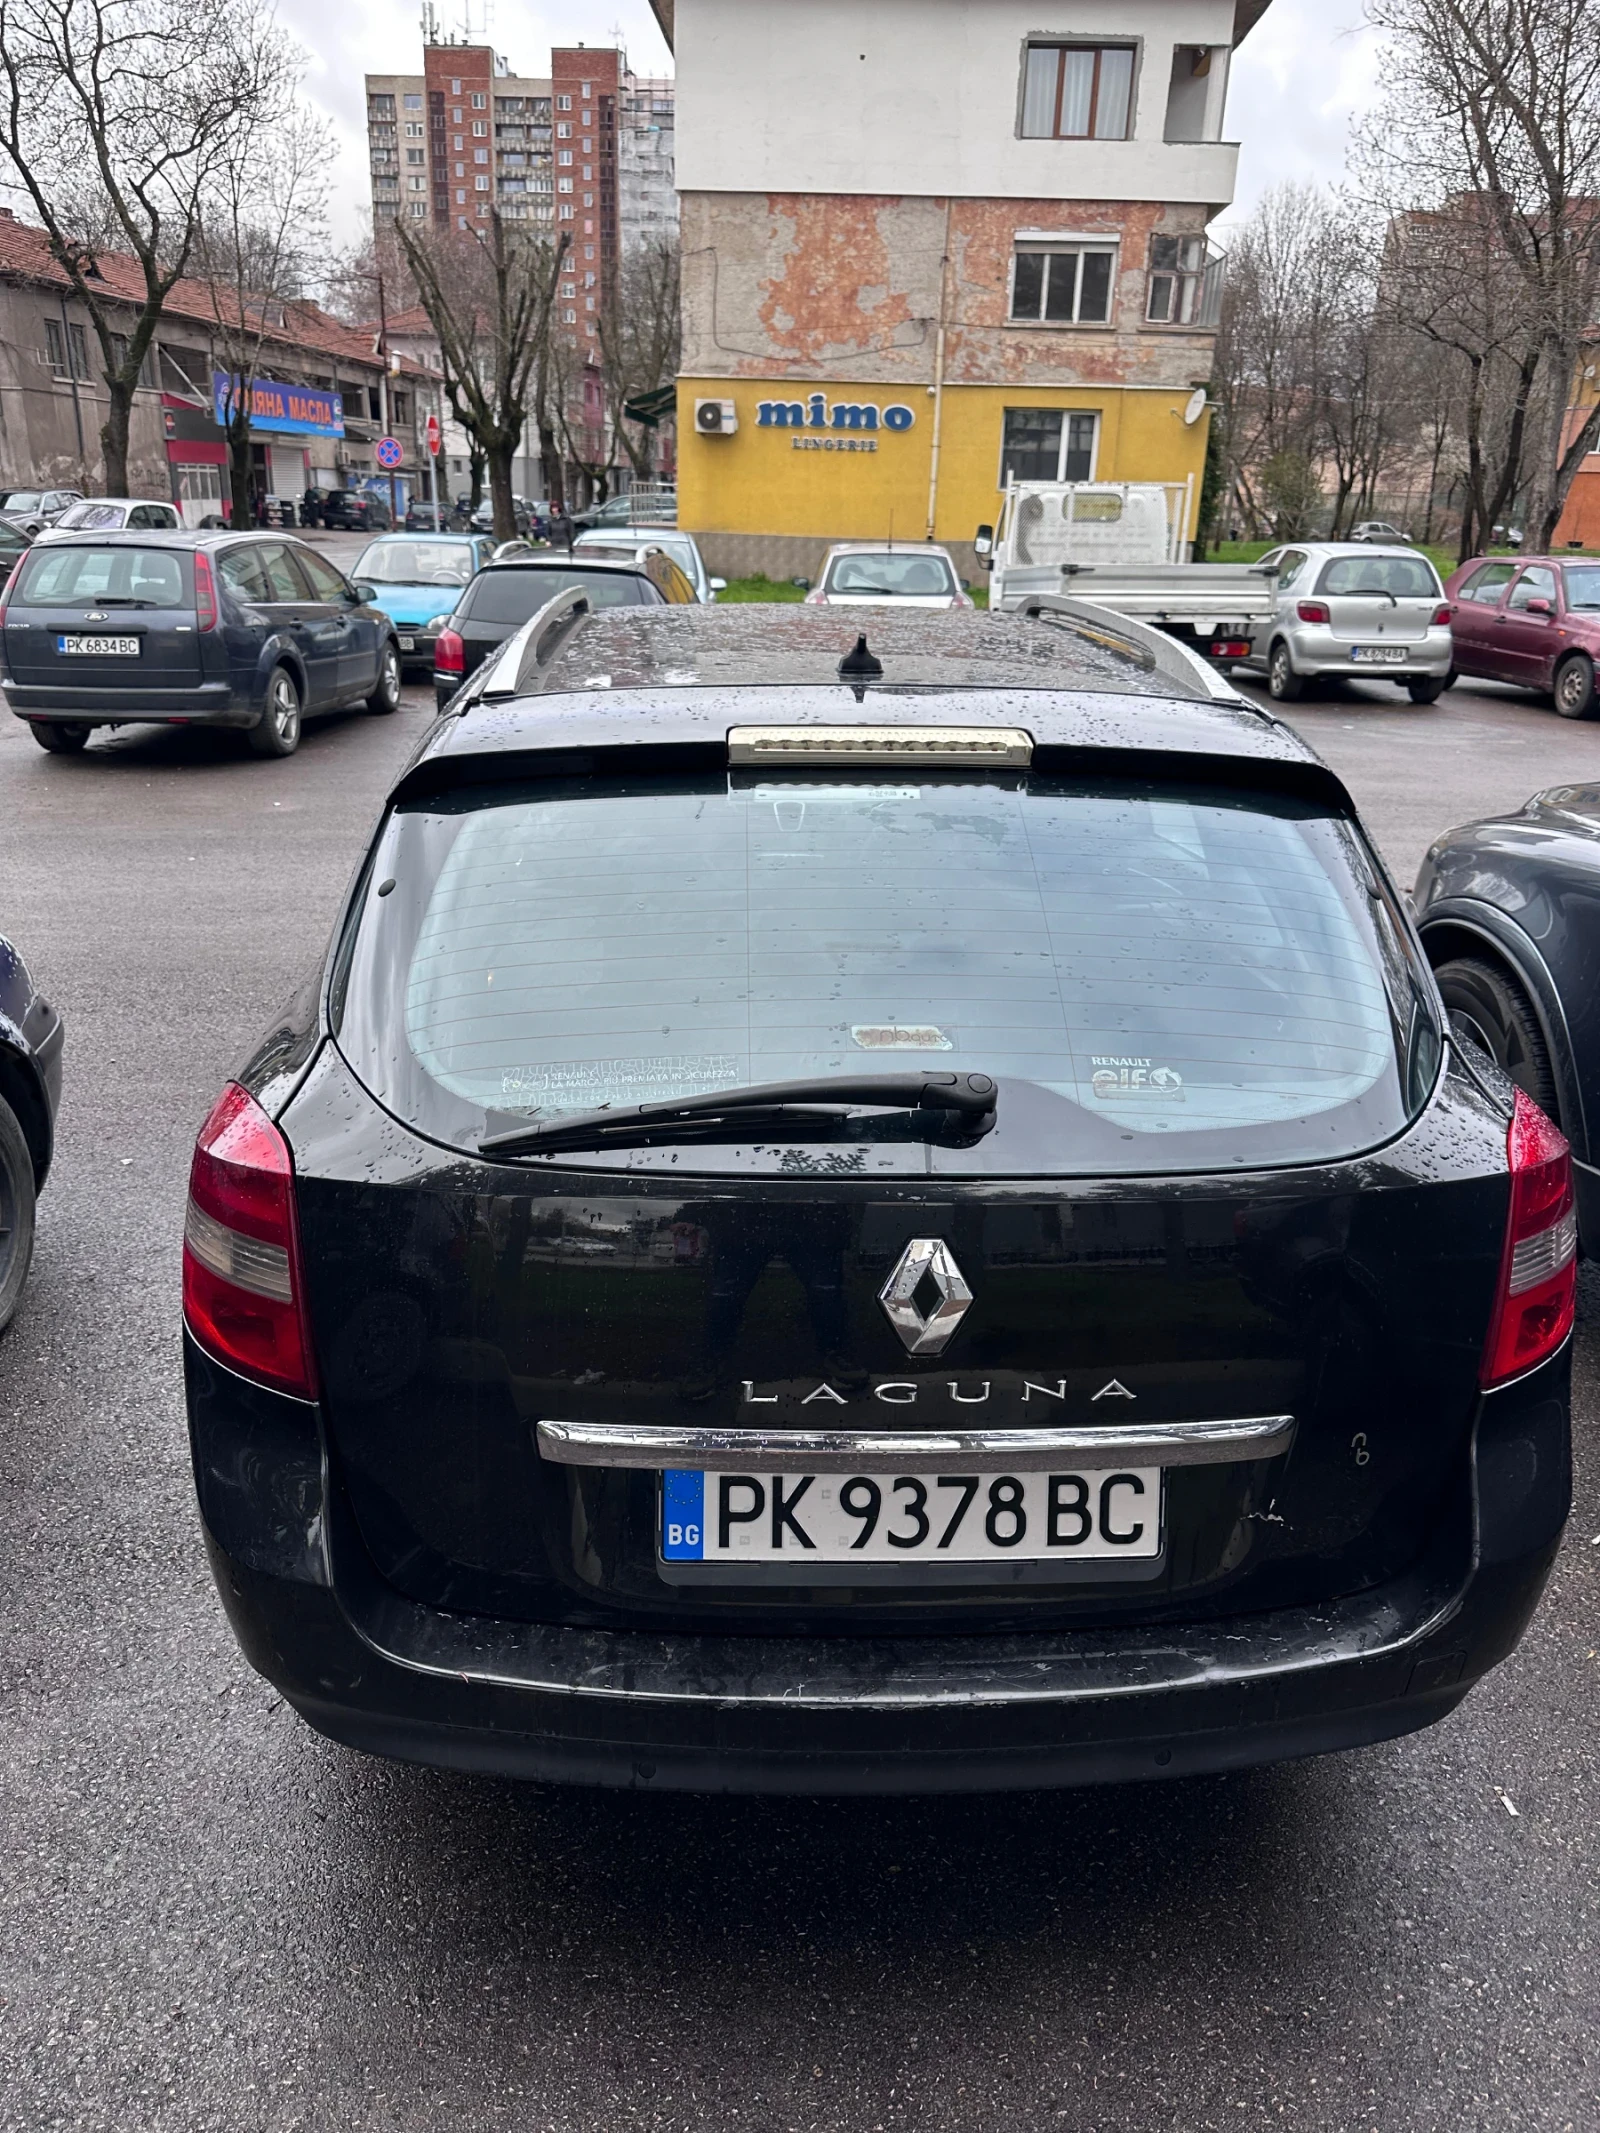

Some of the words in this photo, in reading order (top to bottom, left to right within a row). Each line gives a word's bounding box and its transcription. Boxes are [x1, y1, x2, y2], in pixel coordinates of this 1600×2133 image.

[288, 395, 333, 424] МАСЛА
[755, 392, 916, 432] mimo
[792, 436, 878, 453] LINGERIE
[66, 639, 83, 652] PK
[86, 639, 117, 653] 6834
[120, 640, 137, 653] BC
[1091, 1056, 1152, 1067] RENAULT
[671, 1072, 682, 1080] IN
[1092, 1069, 1147, 1090] elf
[741, 1379, 1138, 1405] LAGUNA
[718, 1475, 817, 1549] PK
[839, 1475, 1027, 1549] 9378
[1046, 1473, 1145, 1546] BC
[668, 1523, 700, 1546] BG
